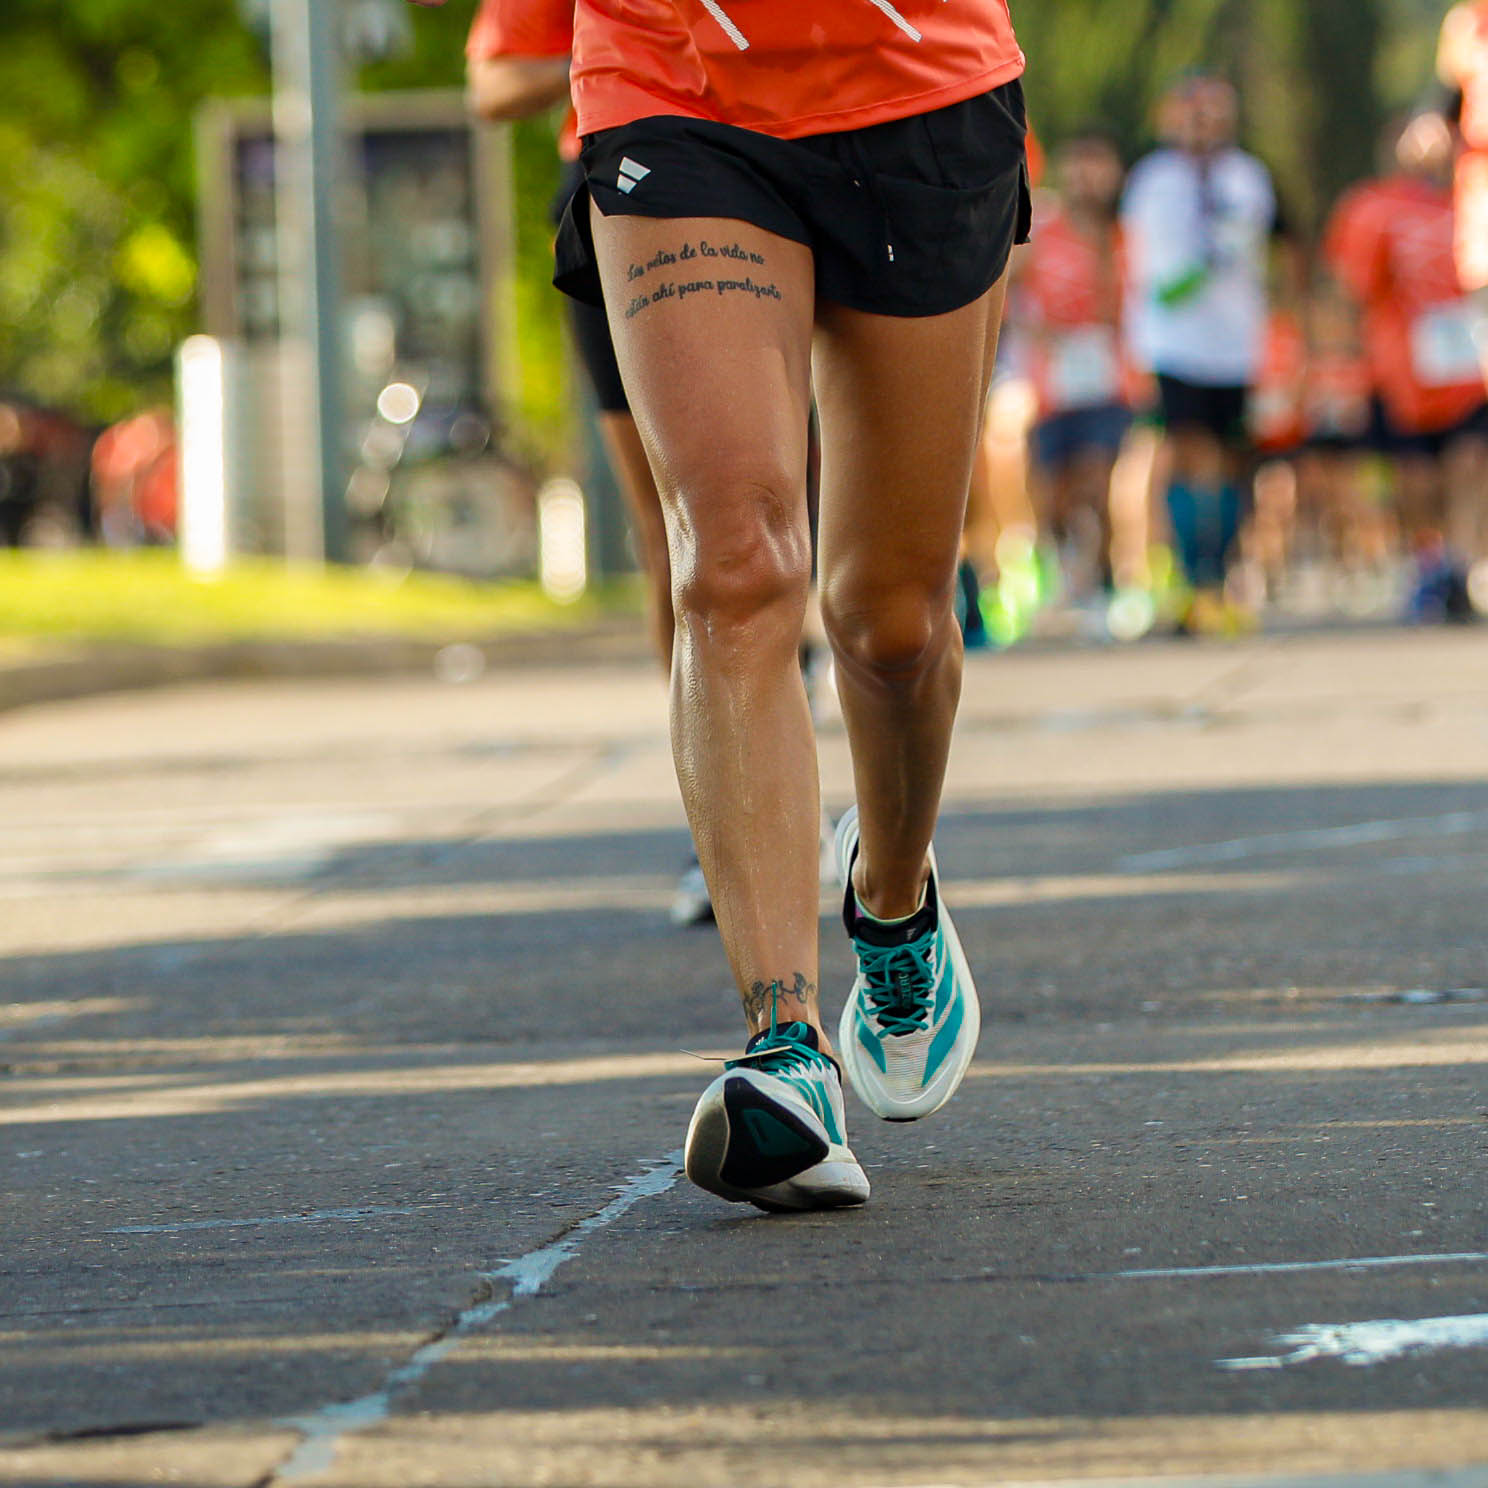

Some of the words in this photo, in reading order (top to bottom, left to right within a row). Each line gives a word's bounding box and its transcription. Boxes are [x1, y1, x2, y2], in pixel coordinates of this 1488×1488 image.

[680, 243, 697, 261] de
[700, 240, 718, 258] la
[720, 243, 748, 261] vida
[652, 282, 676, 302] ahí
[678, 279, 714, 300] para
